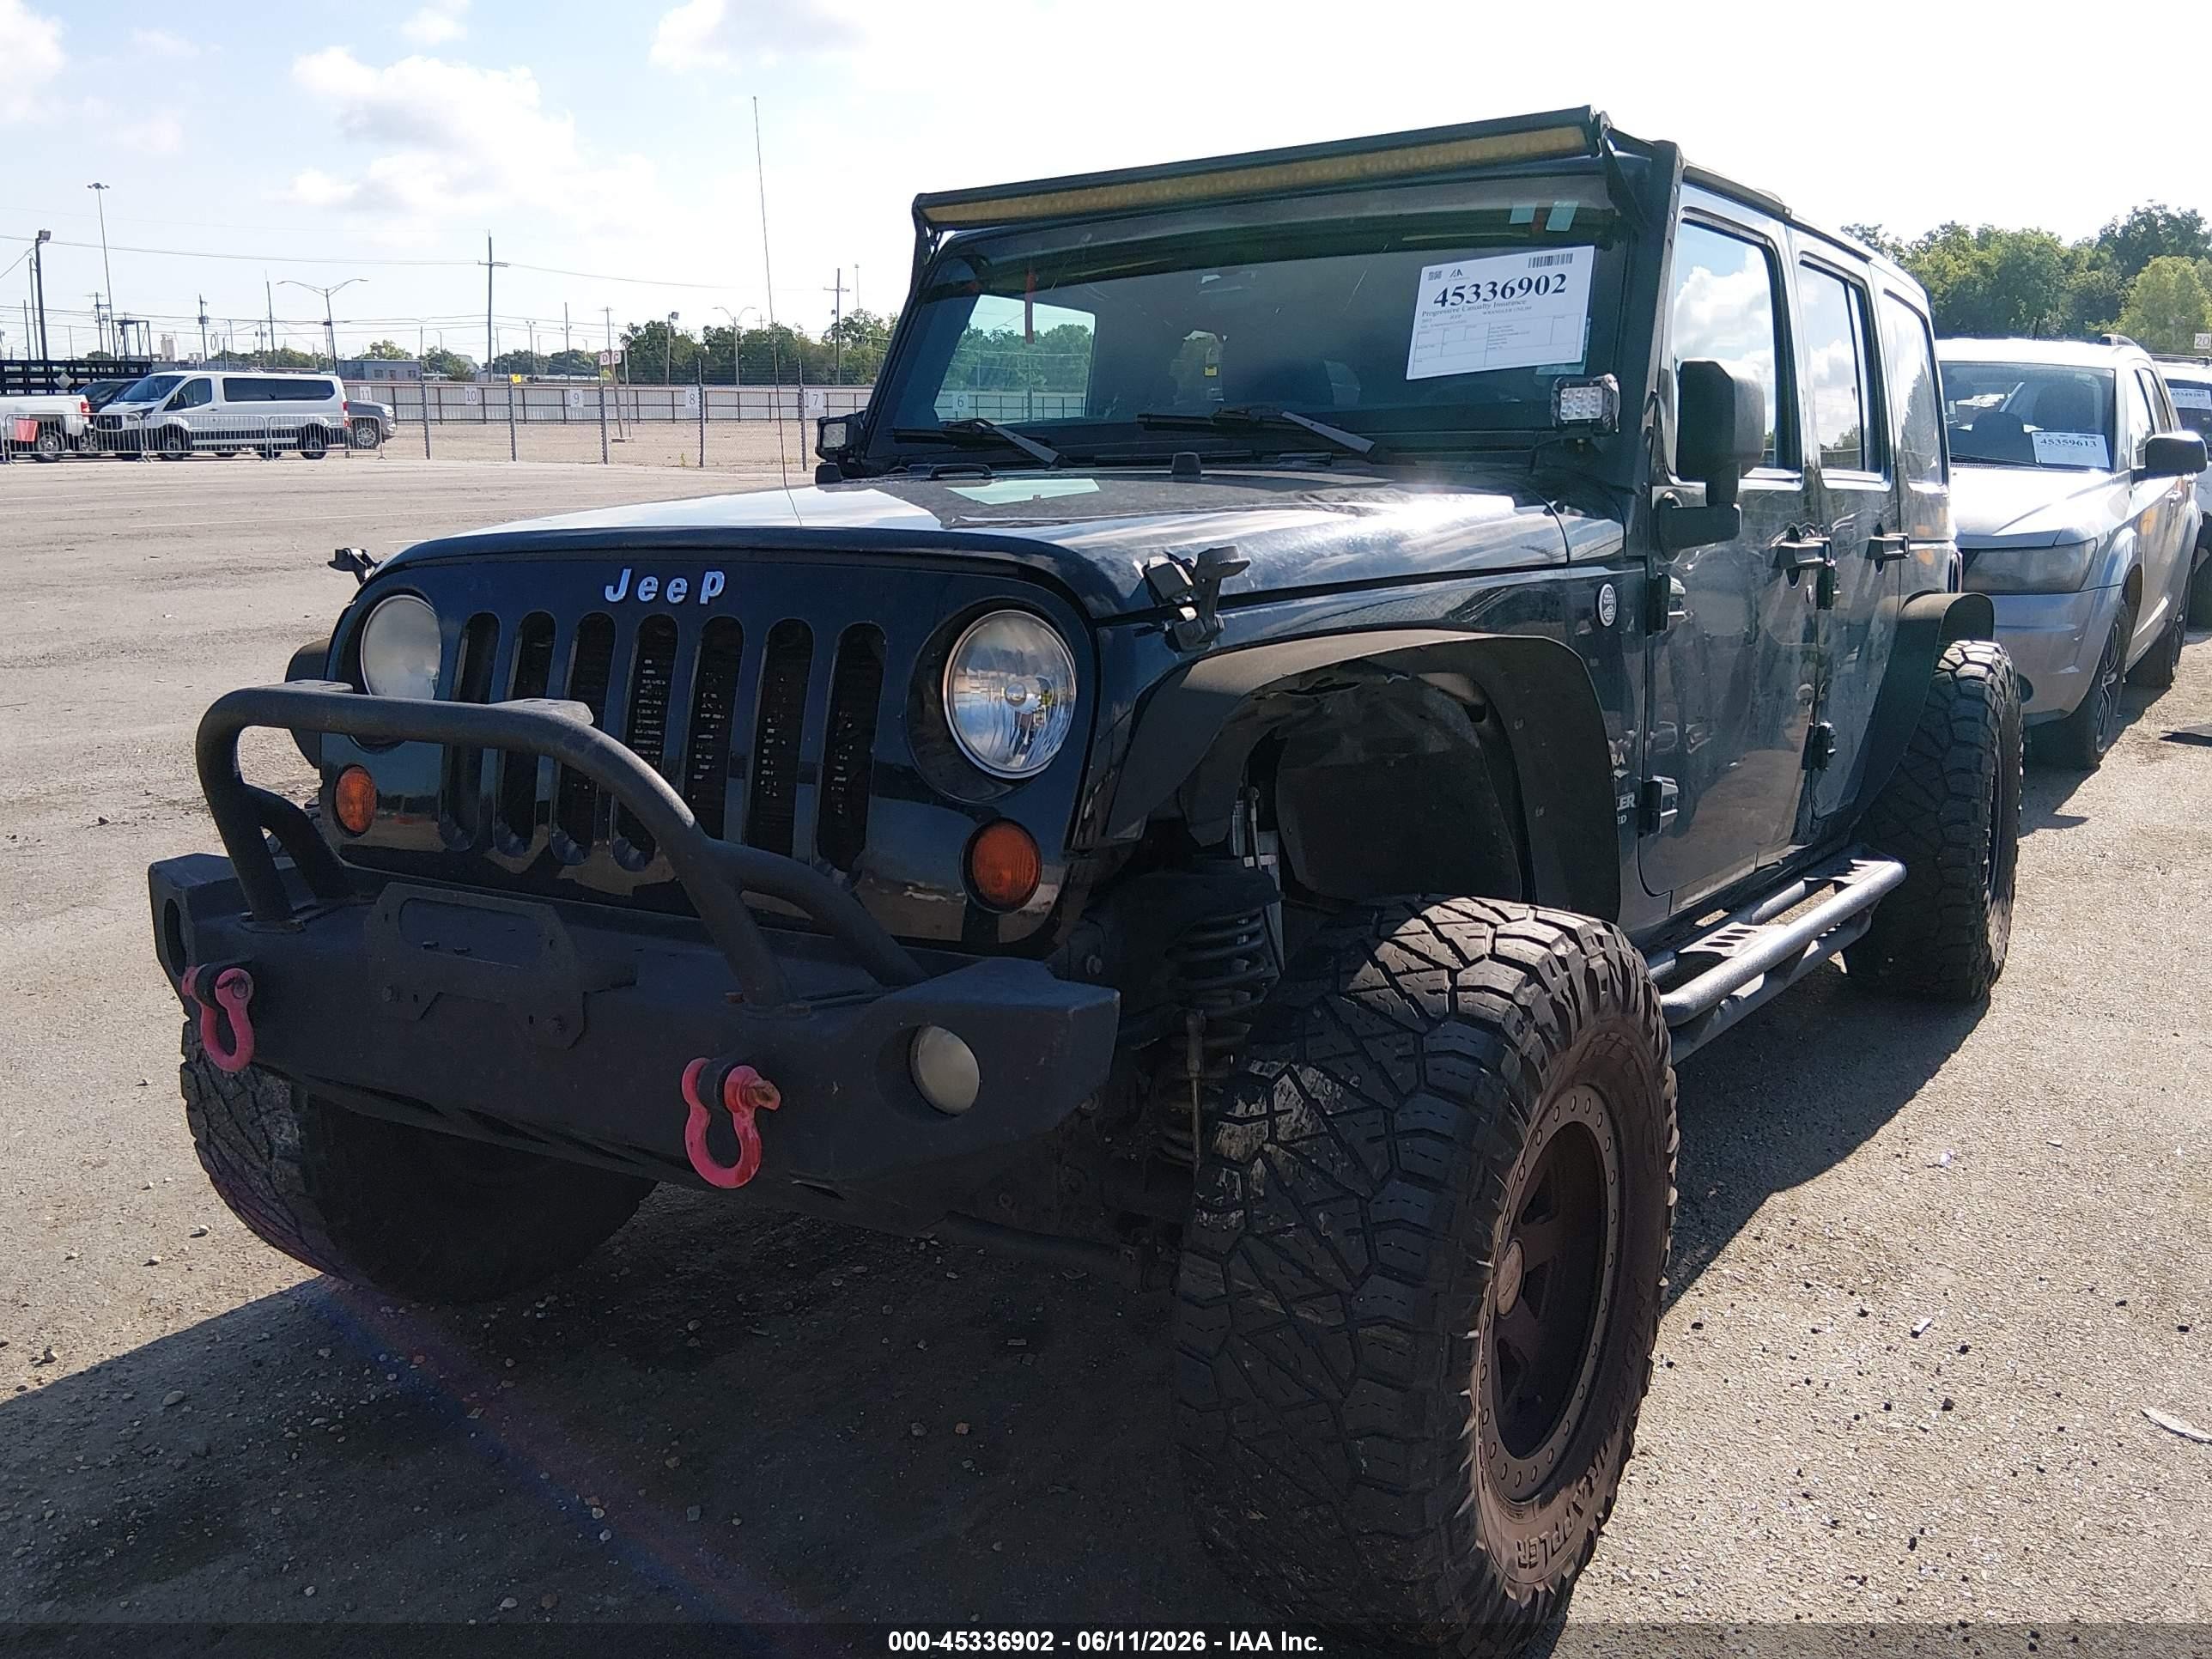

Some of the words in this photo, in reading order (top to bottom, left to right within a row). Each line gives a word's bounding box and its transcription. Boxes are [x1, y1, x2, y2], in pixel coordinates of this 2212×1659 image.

[1433, 273, 1567, 307] 45336902
[1422, 307, 1461, 318] Progressive
[1462, 302, 1492, 313] Casualty
[1493, 300, 1526, 308] Insurance
[2196, 336, 2210, 347] 20
[466, 390, 477, 402] 10
[573, 392, 580, 404] 9
[689, 392, 696, 405] 8
[812, 393, 819, 406] 7
[957, 396, 964, 408] 6
[2040, 438, 2097, 447] 45359613
[605, 568, 726, 605] Jeep
